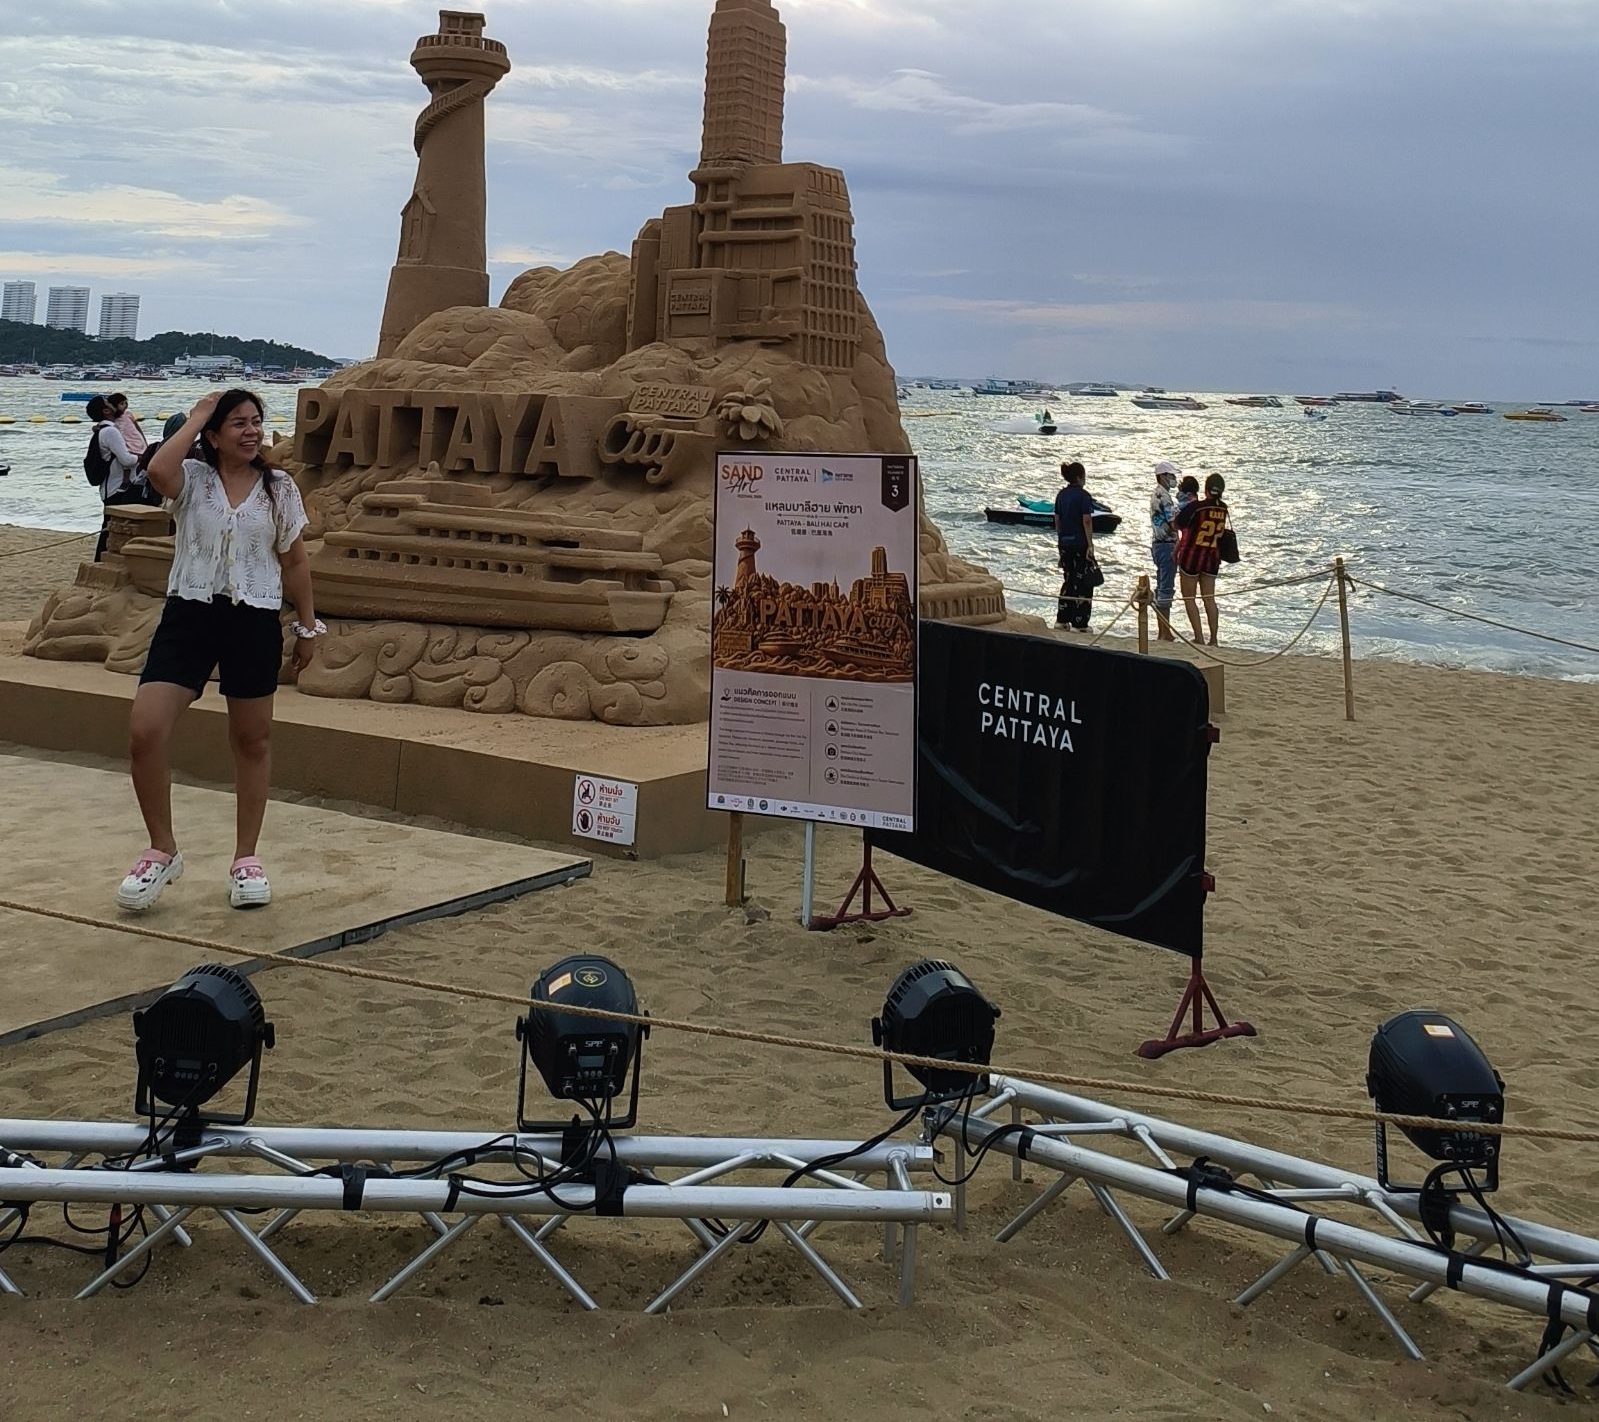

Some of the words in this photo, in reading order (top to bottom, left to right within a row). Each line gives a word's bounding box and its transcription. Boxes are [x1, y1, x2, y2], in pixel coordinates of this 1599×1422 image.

[639, 385, 711, 403] CENTRAL
[635, 398, 700, 414] PATTAYA
[294, 388, 568, 476] PATTAYA
[721, 464, 764, 481] SAND
[774, 467, 811, 476] CENTRAL
[776, 475, 809, 483] PATTAYA
[891, 484, 899, 498] 3
[765, 501, 831, 513] แหลมบาลีฮาย
[834, 502, 863, 515] พัทยา
[776, 519, 802, 527] PATTAYA
[833, 521, 849, 529] CAPE
[760, 599, 867, 631] PATTAYA
[734, 696, 753, 704] DESIGN
[978, 683, 1082, 724] CENTRAL
[981, 711, 1074, 753] PATTAYA
[599, 784, 623, 795] ห้ามนั่ง
[597, 812, 621, 825] ห้ามจับ
